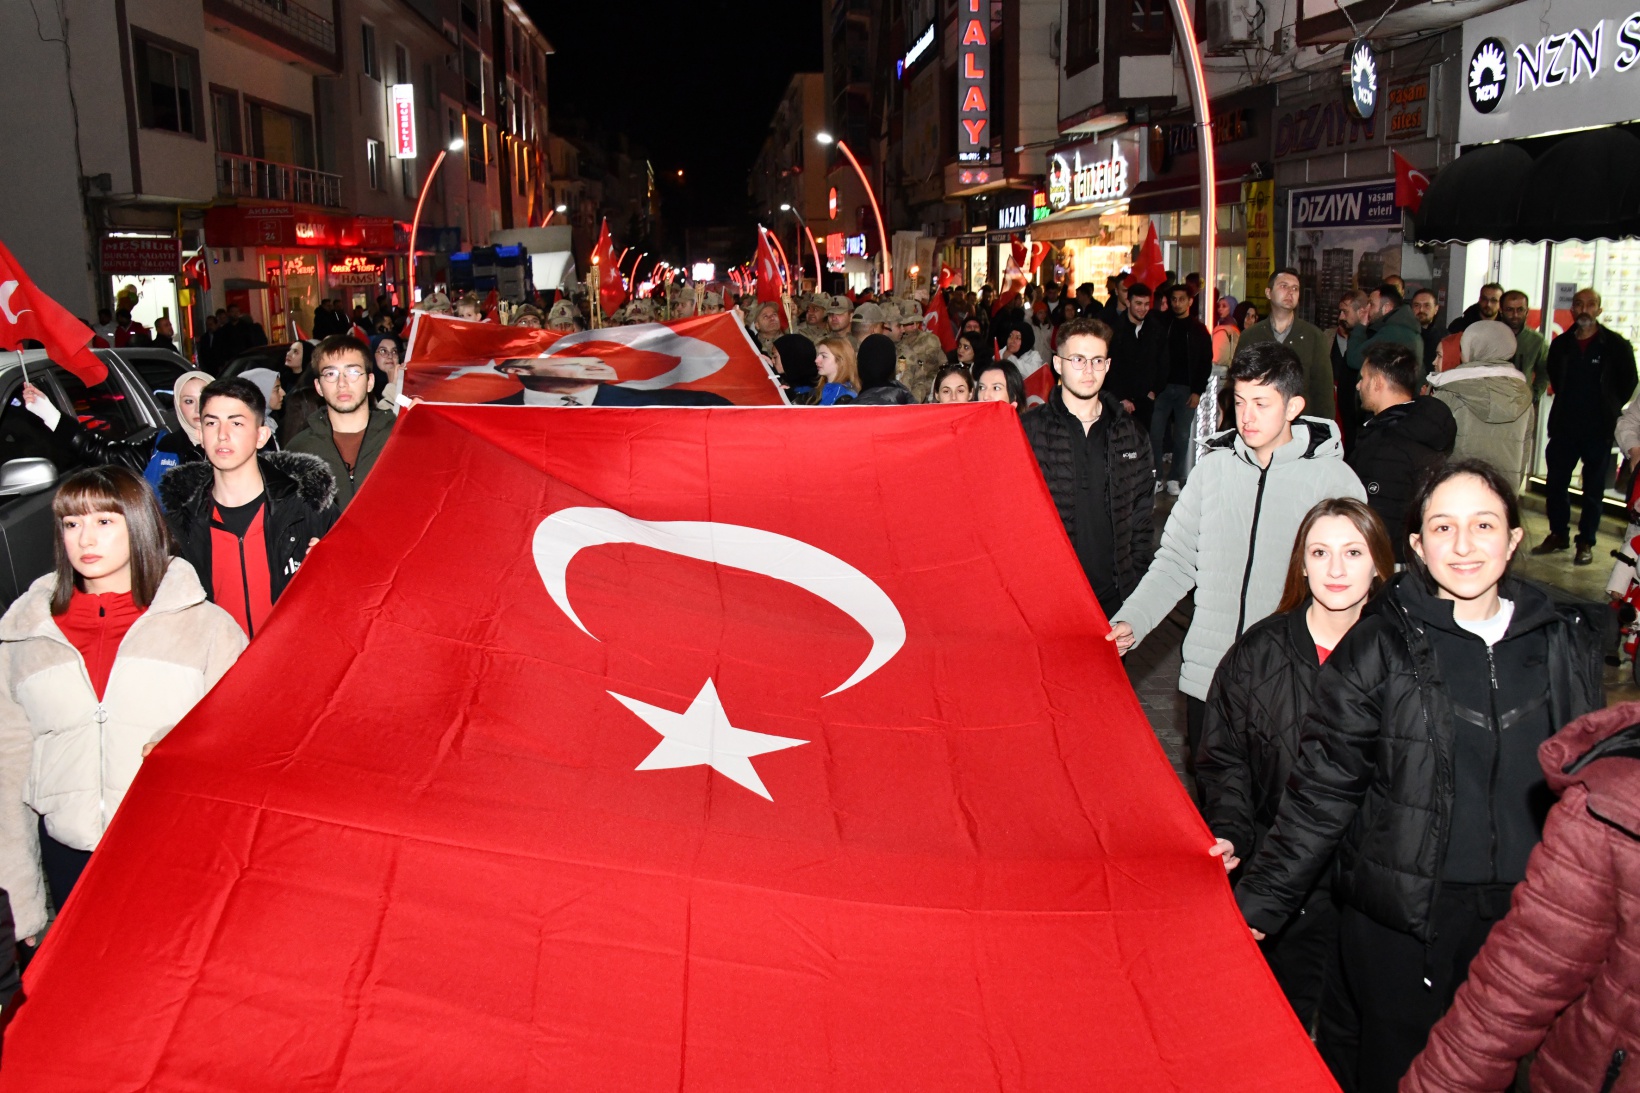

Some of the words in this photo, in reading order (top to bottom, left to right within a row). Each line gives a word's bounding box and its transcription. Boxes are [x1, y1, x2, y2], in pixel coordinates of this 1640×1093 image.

[1513, 19, 1605, 94] NZN
[1357, 86, 1373, 107] NZN
[1389, 83, 1427, 110] yaşam
[1475, 82, 1500, 102] NZN
[1391, 107, 1422, 131] sitesi
[1368, 192, 1394, 204] yaşam
[248, 207, 289, 215] AKBANK
[999, 204, 1026, 229] NAZAR
[1368, 205, 1393, 216] evleri
[265, 232, 276, 241] 24
